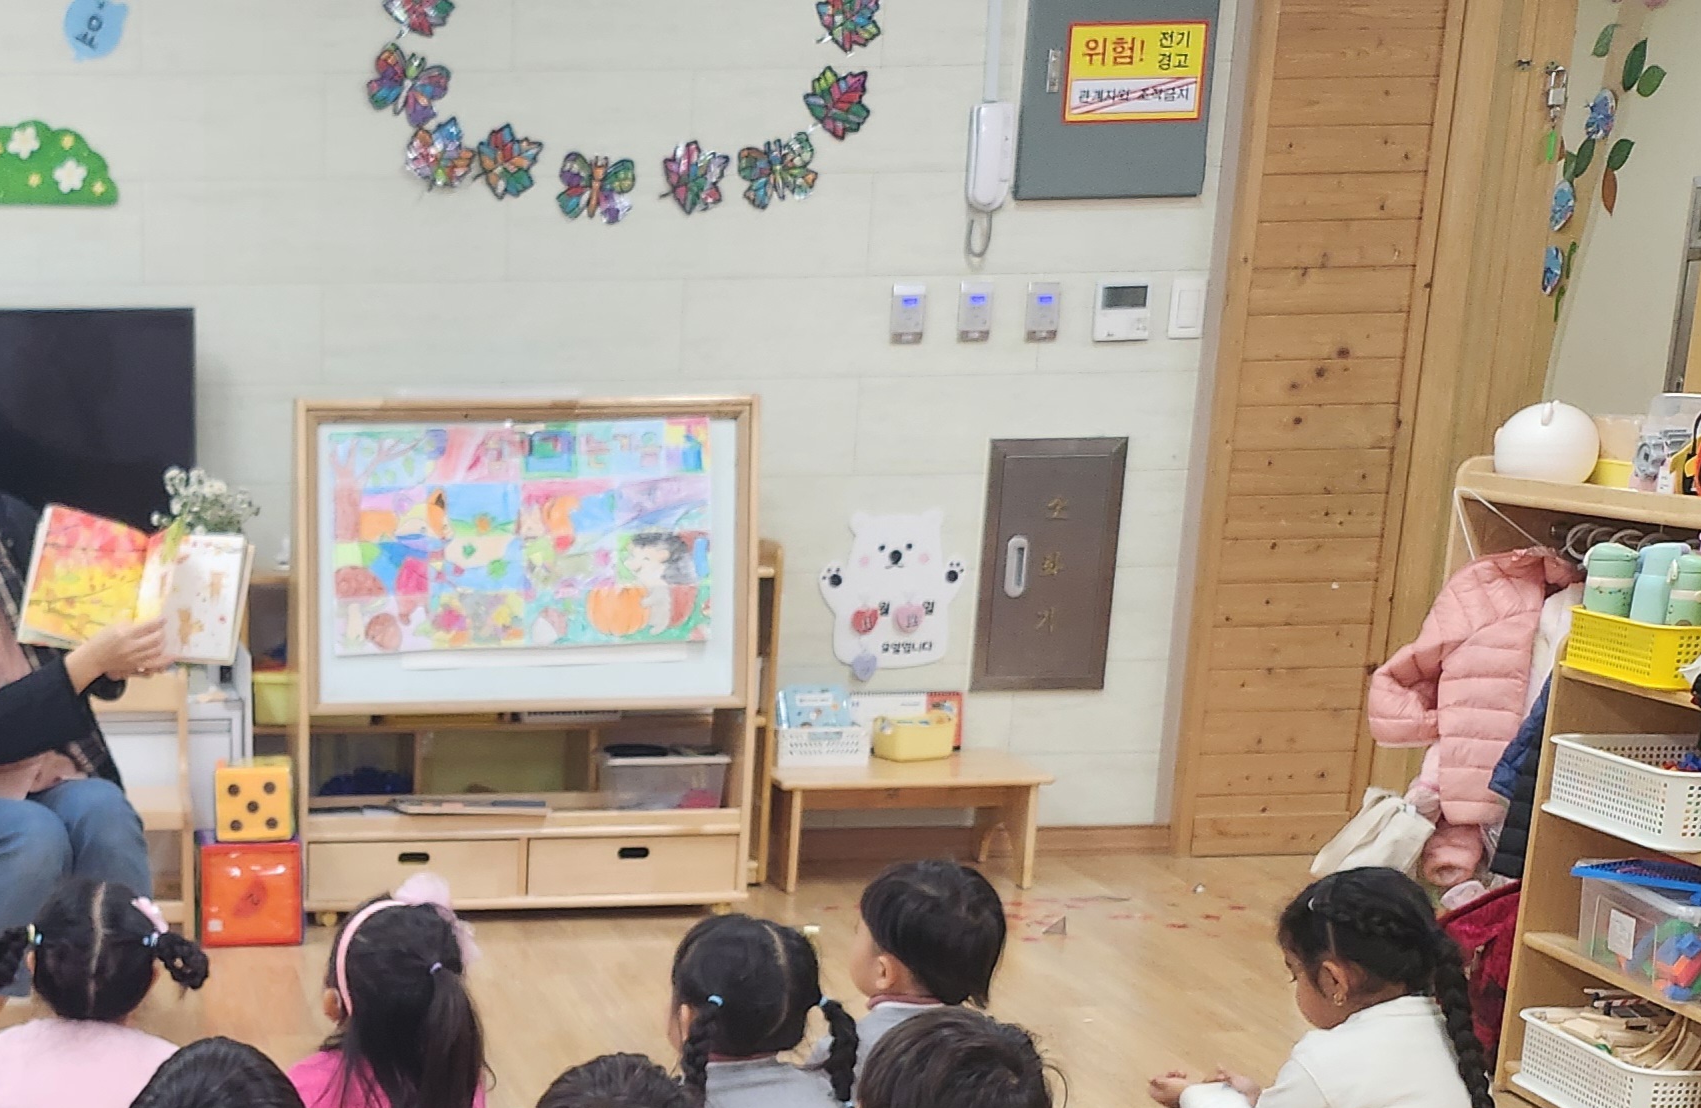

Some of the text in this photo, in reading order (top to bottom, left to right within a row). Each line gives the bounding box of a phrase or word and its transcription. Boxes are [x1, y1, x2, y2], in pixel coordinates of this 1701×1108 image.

[1159, 30, 1191, 49] 전기
[1082, 36, 1145, 66] 위험!
[1158, 52, 1190, 71] 경고
[881, 640, 933, 654] 요일입니다
